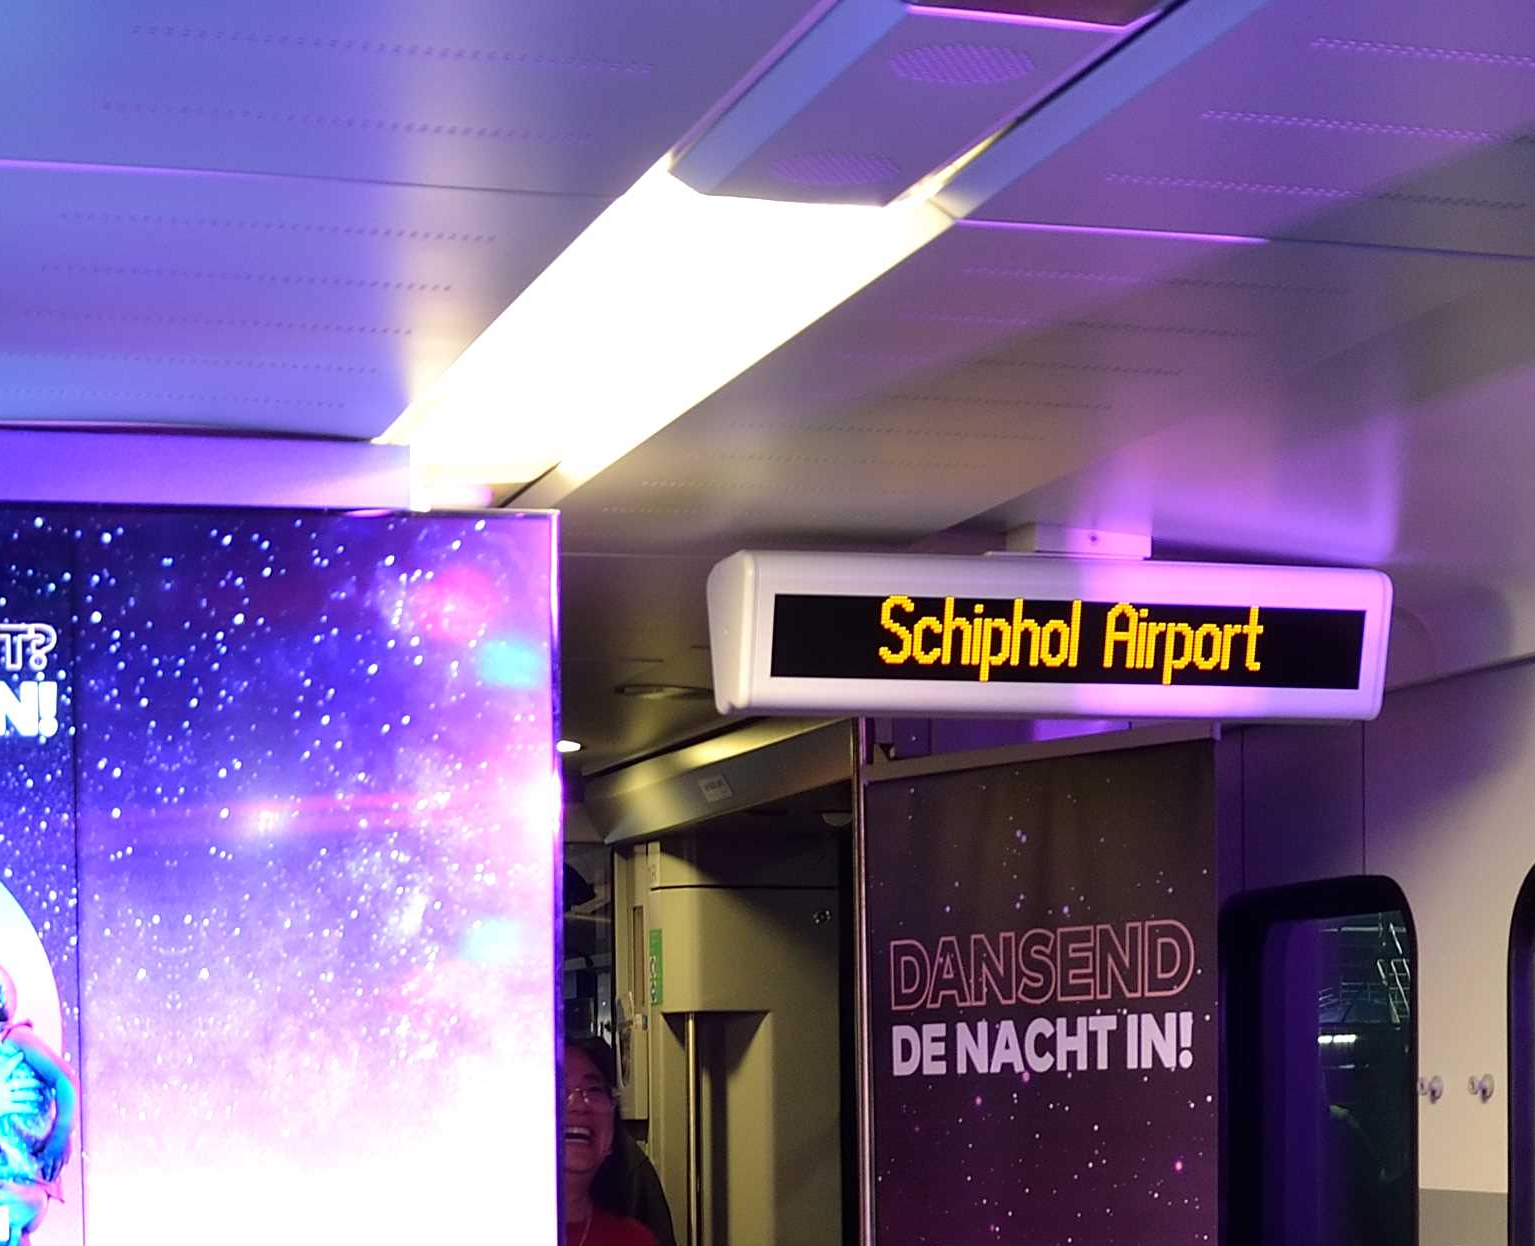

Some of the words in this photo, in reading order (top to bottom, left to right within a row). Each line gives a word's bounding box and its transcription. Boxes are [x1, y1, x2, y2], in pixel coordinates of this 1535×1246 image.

[879, 594, 1082, 682] Schiphol
[1103, 602, 1265, 686] Airport
[889, 920, 1196, 1011] DANSEND
[892, 1024, 948, 1077] DE
[956, 1015, 1119, 1076] NACHT
[1126, 1011, 1195, 1073] IN!
